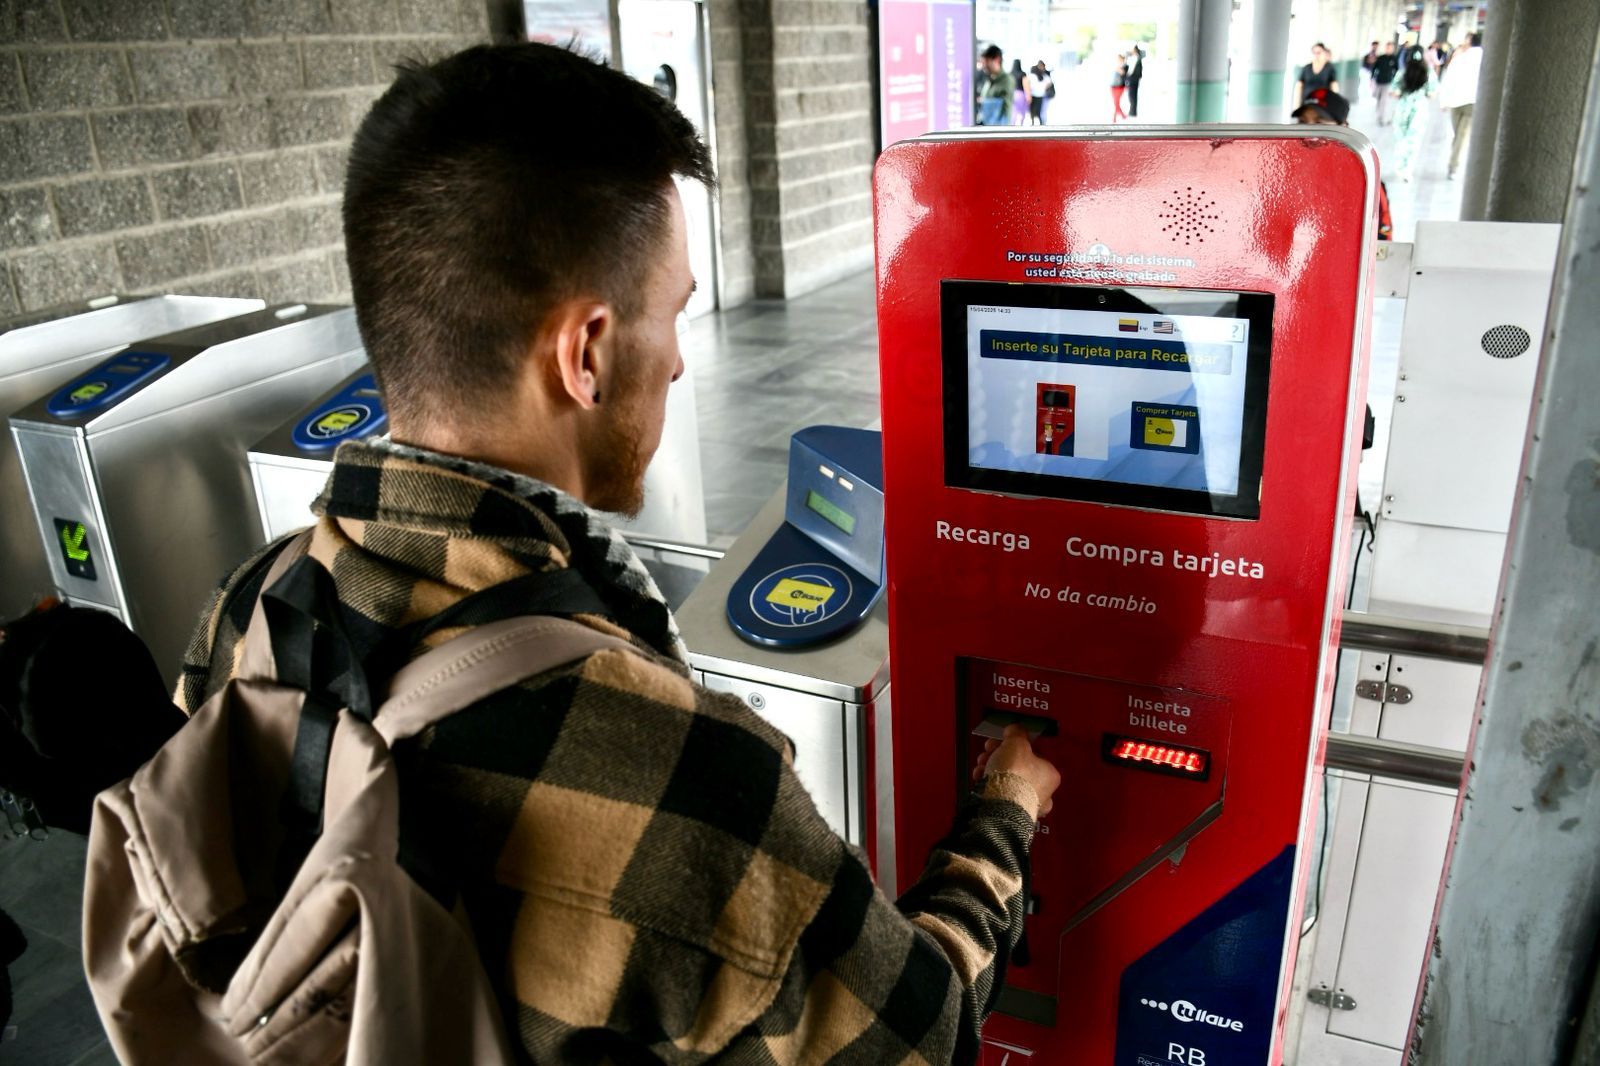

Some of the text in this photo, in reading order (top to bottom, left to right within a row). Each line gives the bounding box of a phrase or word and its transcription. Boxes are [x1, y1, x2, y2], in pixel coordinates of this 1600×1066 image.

[1008, 252, 1026, 262] Por
[1029, 253, 1041, 262] su
[1044, 253, 1103, 265] seguridad
[1104, 255, 1111, 266] y
[1113, 253, 1123, 264] la
[1126, 254, 1144, 265] del
[1026, 267, 1057, 277] usted
[1126, 269, 1176, 282] grabado
[992, 339, 1218, 366] Inserte su Tarjeta para Recargar
[1136, 406, 1196, 418] Comprar Tarjeta
[936, 520, 1030, 552] Recarga
[1066, 537, 1264, 579] Compra tarjeta
[1024, 582, 1156, 614] No da cambio
[993, 672, 1050, 694] Inserta
[994, 690, 1049, 710] tarjeta
[1128, 695, 1191, 717] Inserta
[1129, 712, 1187, 734] billete
[1168, 1042, 1206, 1066] RB
